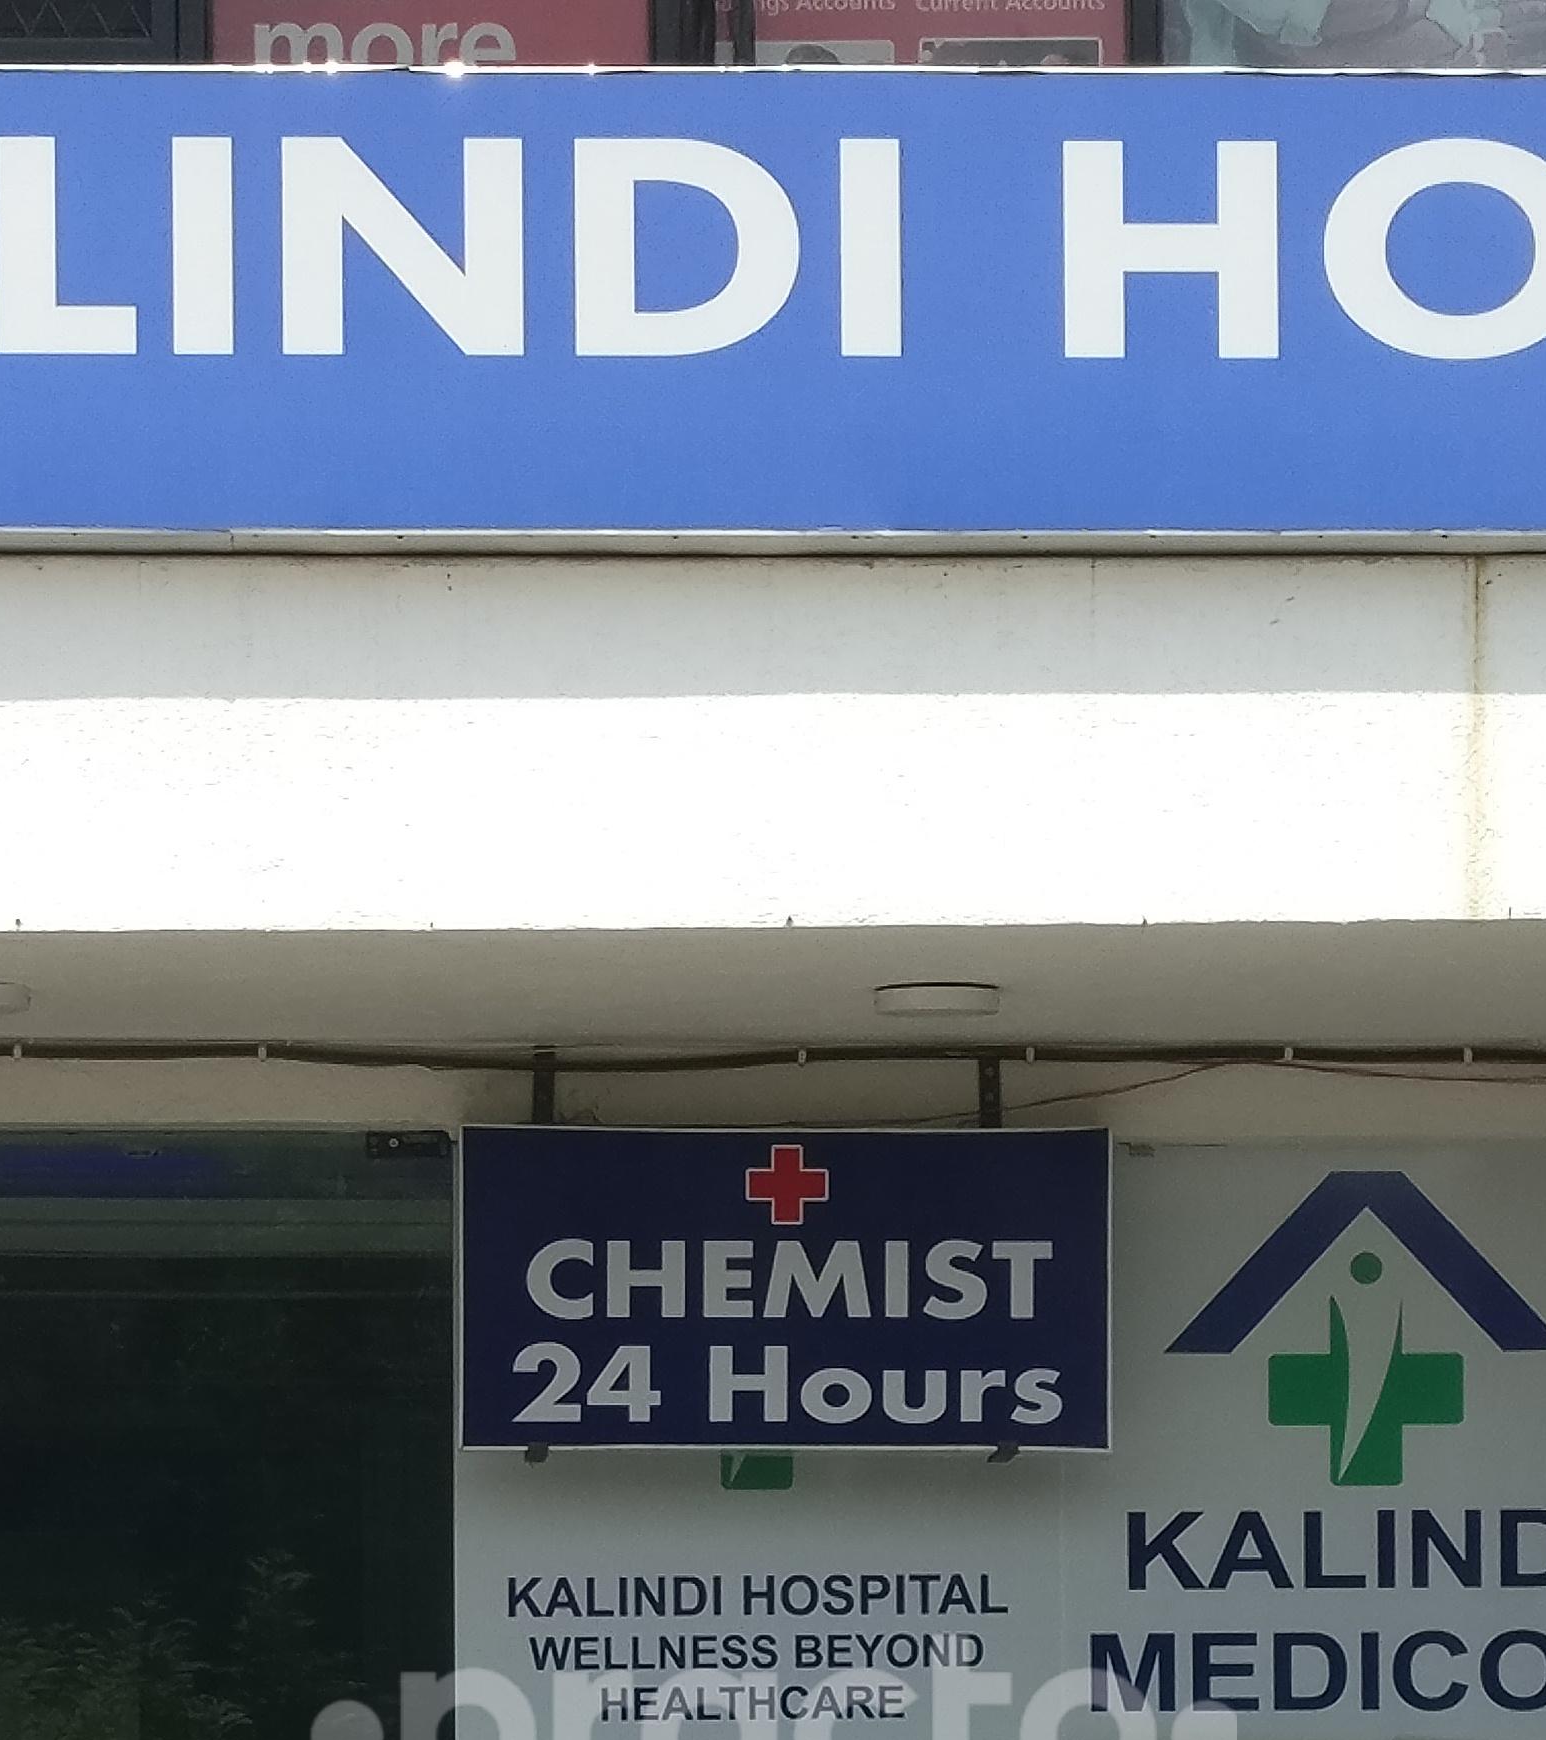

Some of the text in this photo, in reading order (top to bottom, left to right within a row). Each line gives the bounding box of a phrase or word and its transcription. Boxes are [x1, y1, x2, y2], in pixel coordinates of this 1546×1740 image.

[253, 22, 517, 66] more
[526, 1238, 1053, 1320] CHEMIST
[512, 1341, 1063, 1424] 24 Hours
[506, 1573, 1009, 1619] KALINDI HOSPITAL
[528, 1632, 986, 1671] WELLNESS BEYOND
[601, 1684, 906, 1722] HEALTHCARE
